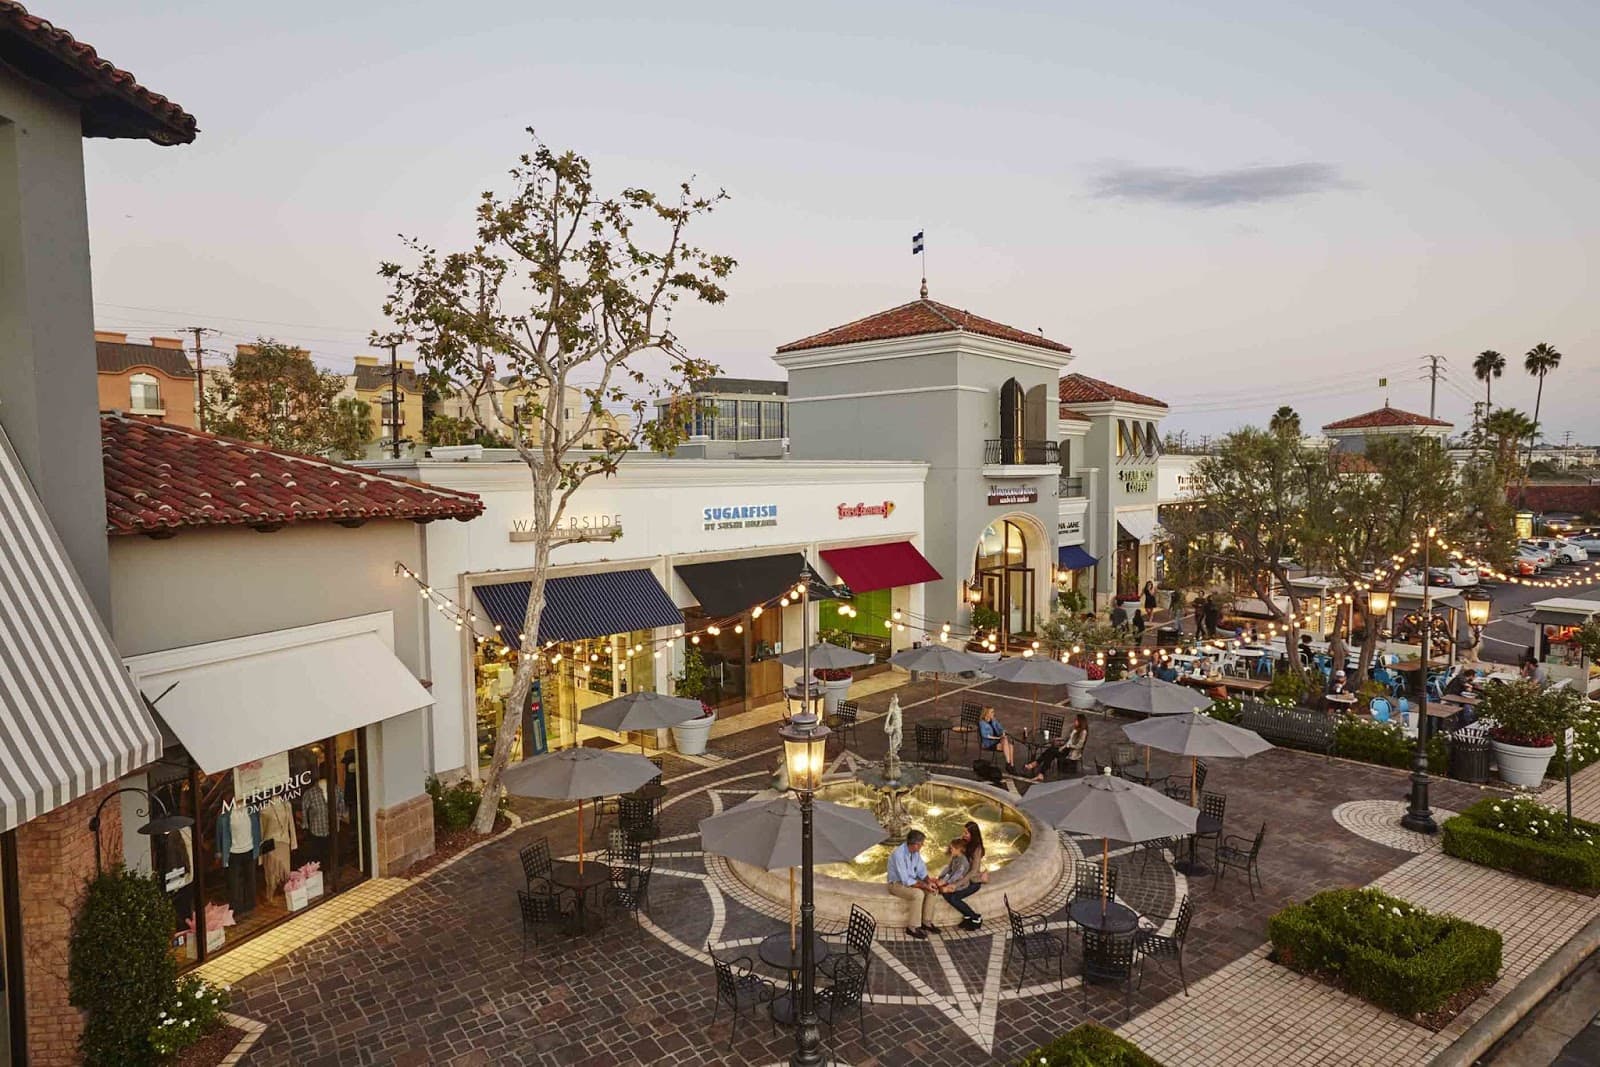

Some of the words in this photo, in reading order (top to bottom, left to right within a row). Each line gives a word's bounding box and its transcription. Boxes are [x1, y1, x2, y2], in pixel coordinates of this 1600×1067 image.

[703, 505, 777, 521] SUGARFISH
[512, 514, 623, 533] WAERSIDE
[241, 770, 312, 807] FREDRIC
